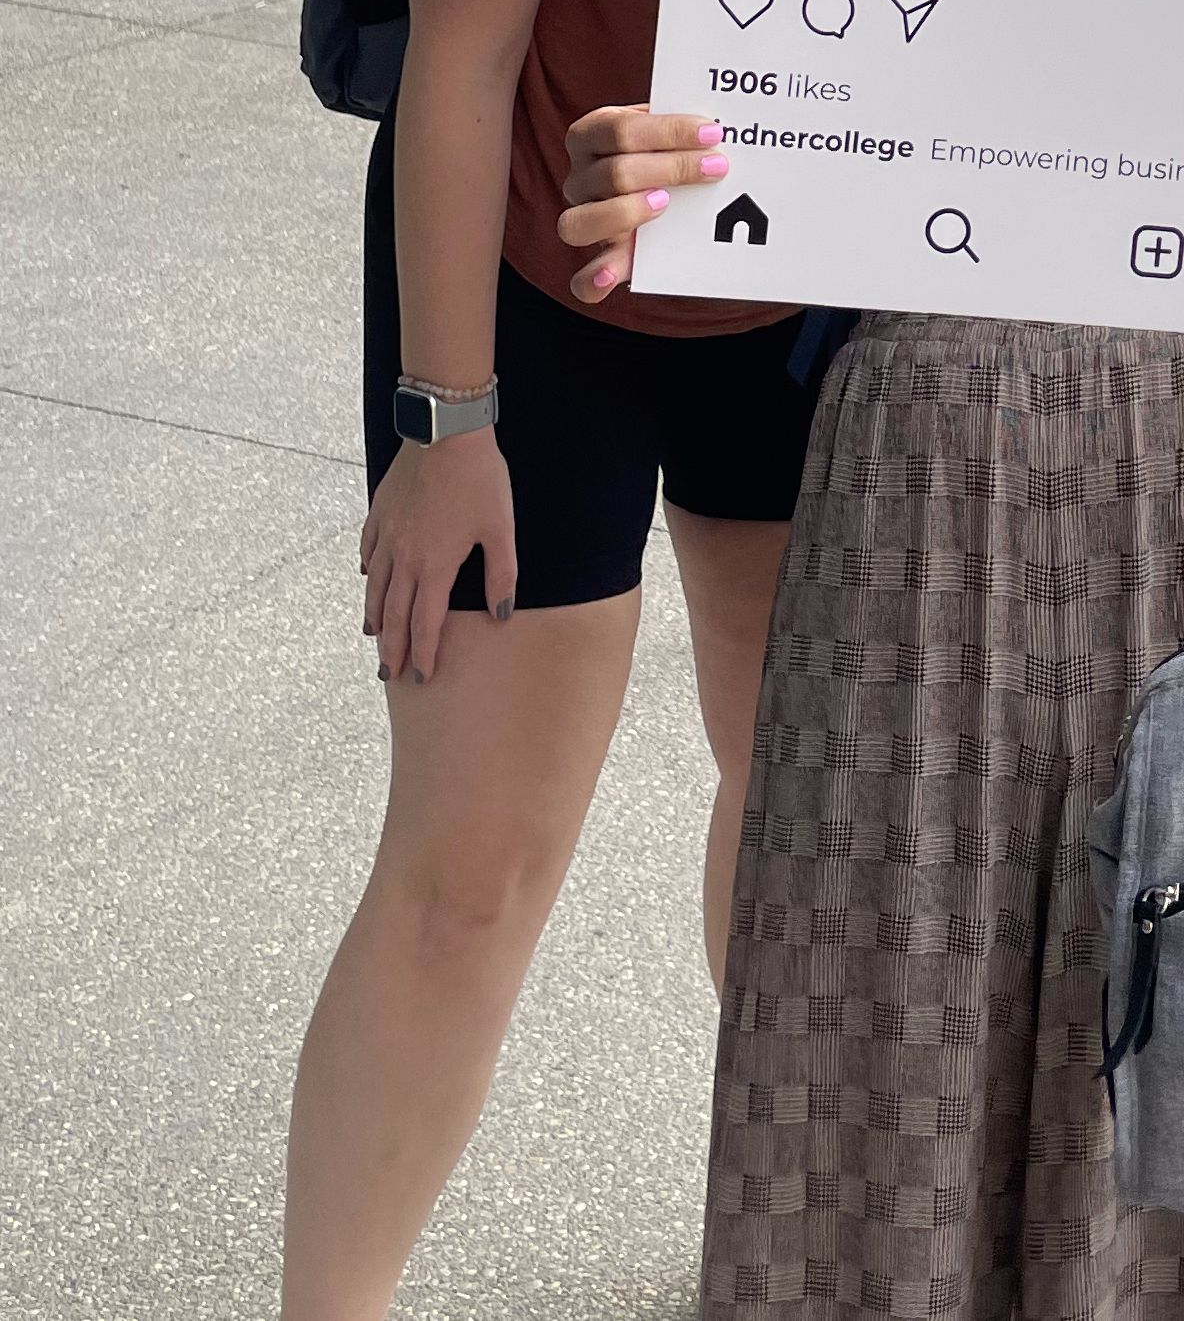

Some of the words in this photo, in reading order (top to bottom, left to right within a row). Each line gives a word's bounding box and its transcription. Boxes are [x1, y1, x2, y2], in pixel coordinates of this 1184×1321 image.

[708, 67, 778, 96] 1906
[787, 72, 852, 102] likes
[713, 118, 915, 162] ndnercollege
[931, 138, 1108, 180] Empowering
